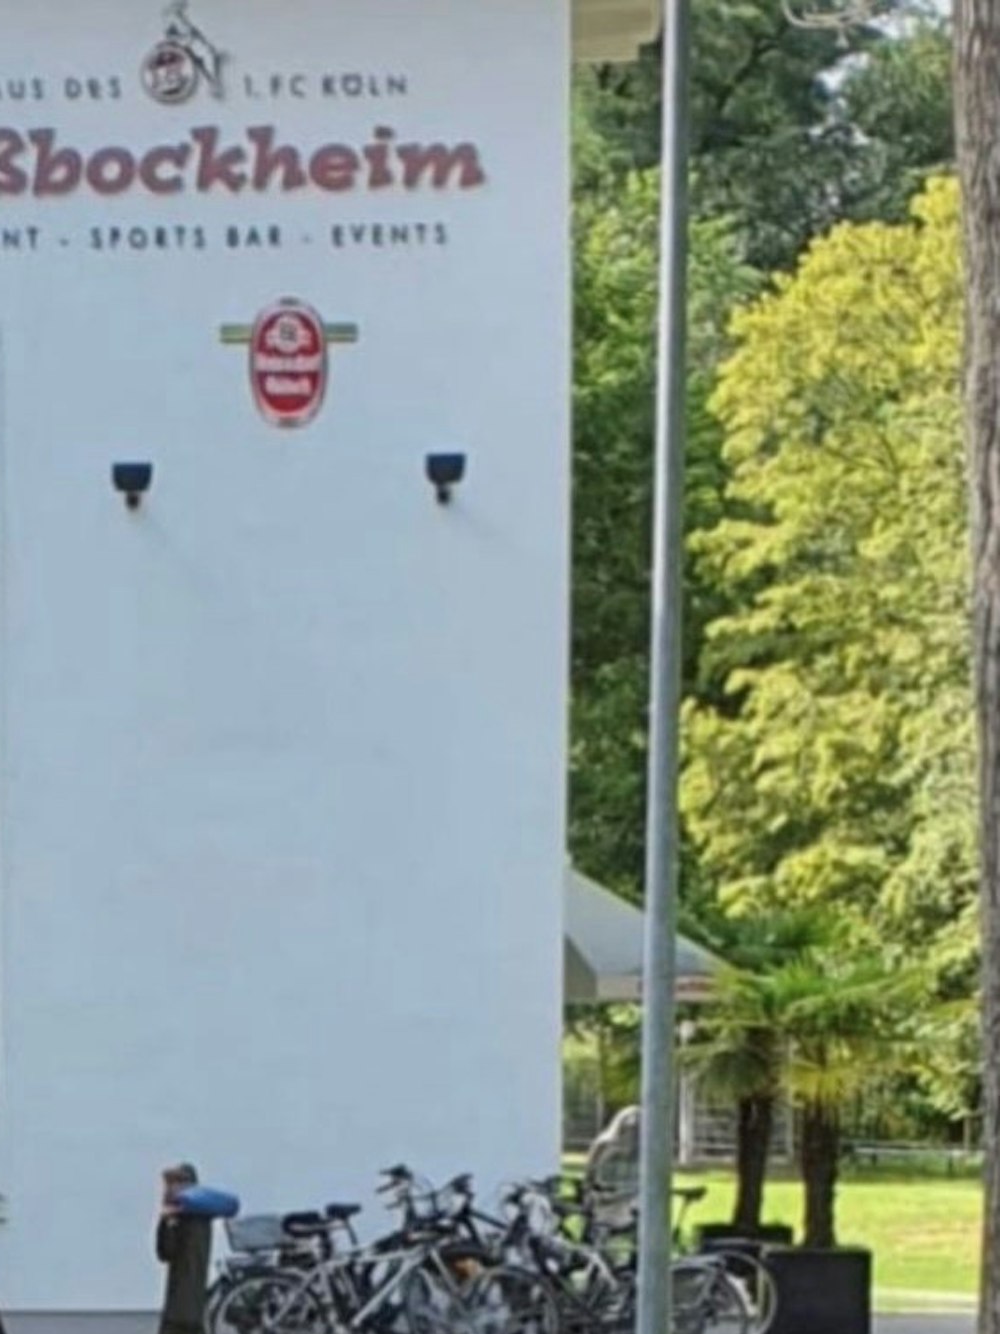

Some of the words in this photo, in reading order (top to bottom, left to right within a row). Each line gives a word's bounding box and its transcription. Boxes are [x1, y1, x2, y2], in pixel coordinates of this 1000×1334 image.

[64, 77, 121, 100] DES
[321, 72, 408, 97] KÖLN
[90, 225, 206, 251] SPORTS
[226, 224, 281, 249] BAR
[331, 222, 447, 249] EVENTS
